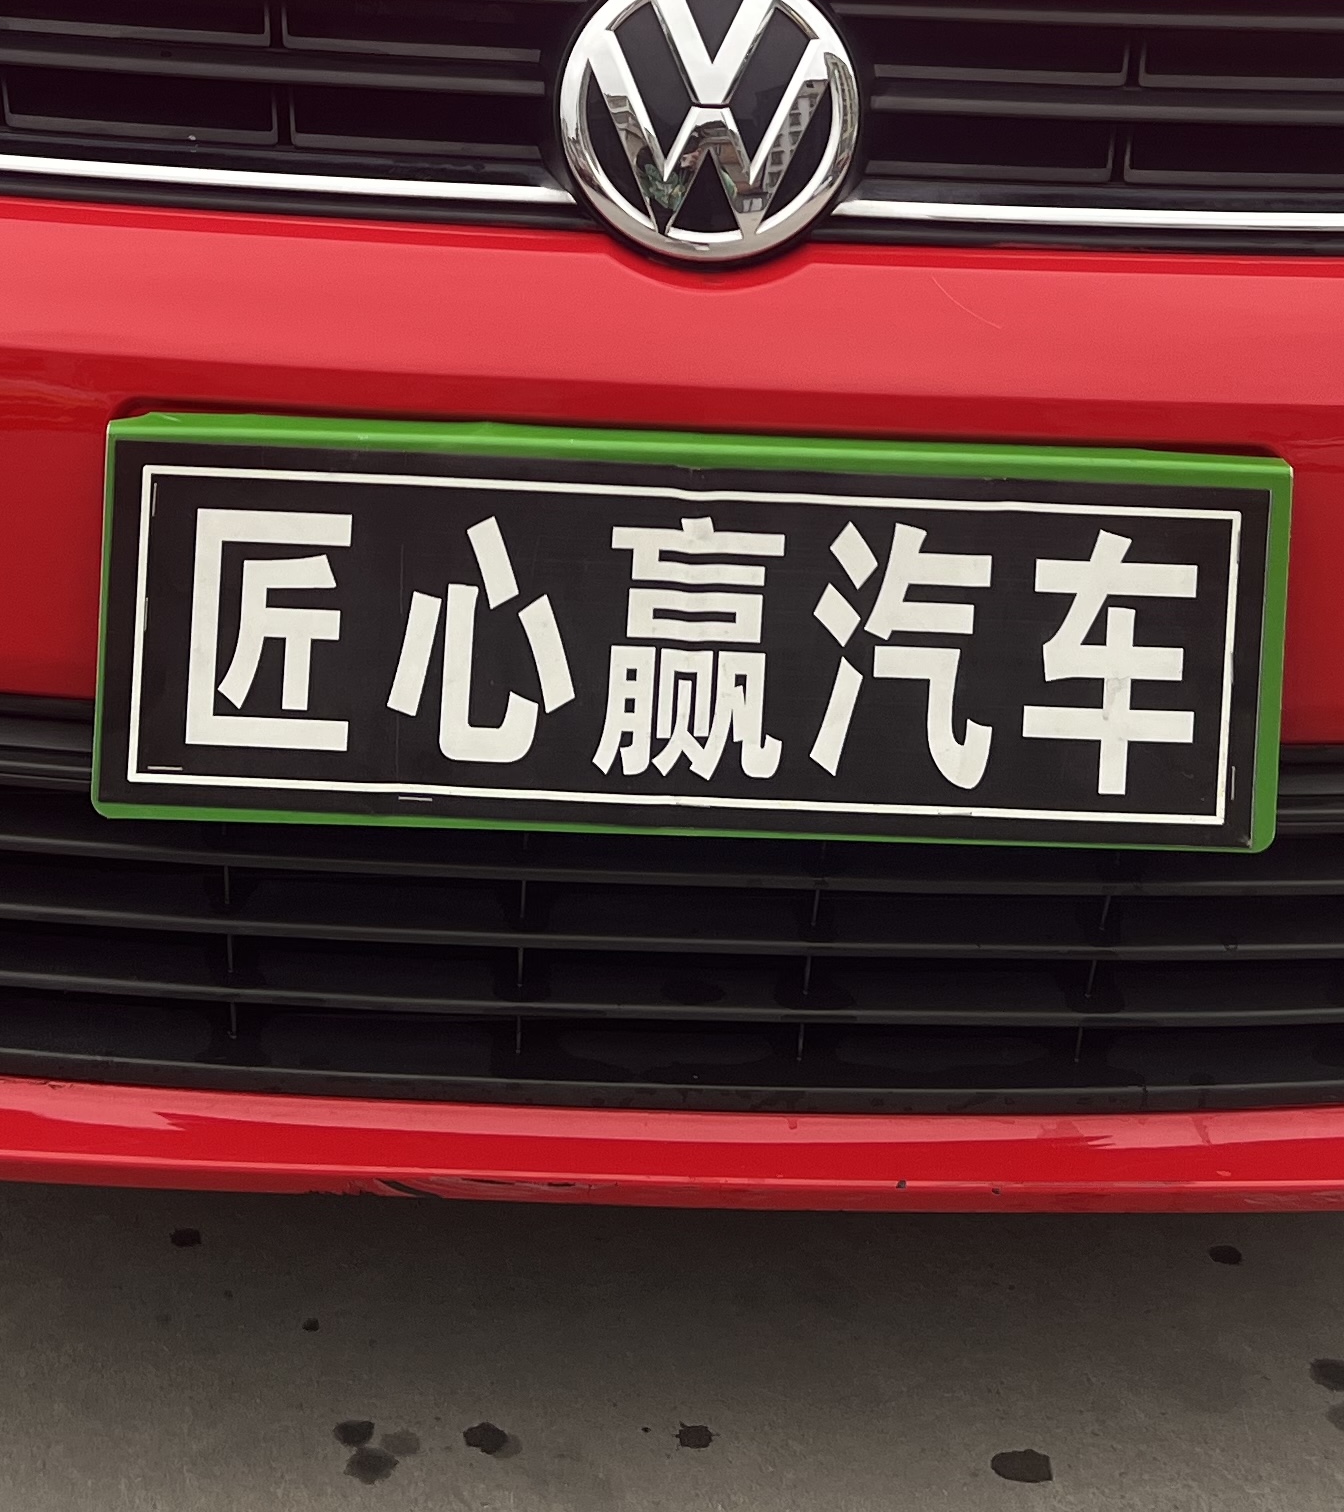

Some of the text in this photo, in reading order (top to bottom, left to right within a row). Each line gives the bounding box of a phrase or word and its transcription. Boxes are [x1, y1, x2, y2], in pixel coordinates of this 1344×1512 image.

[184, 507, 1200, 795] 匠心赢汽车
